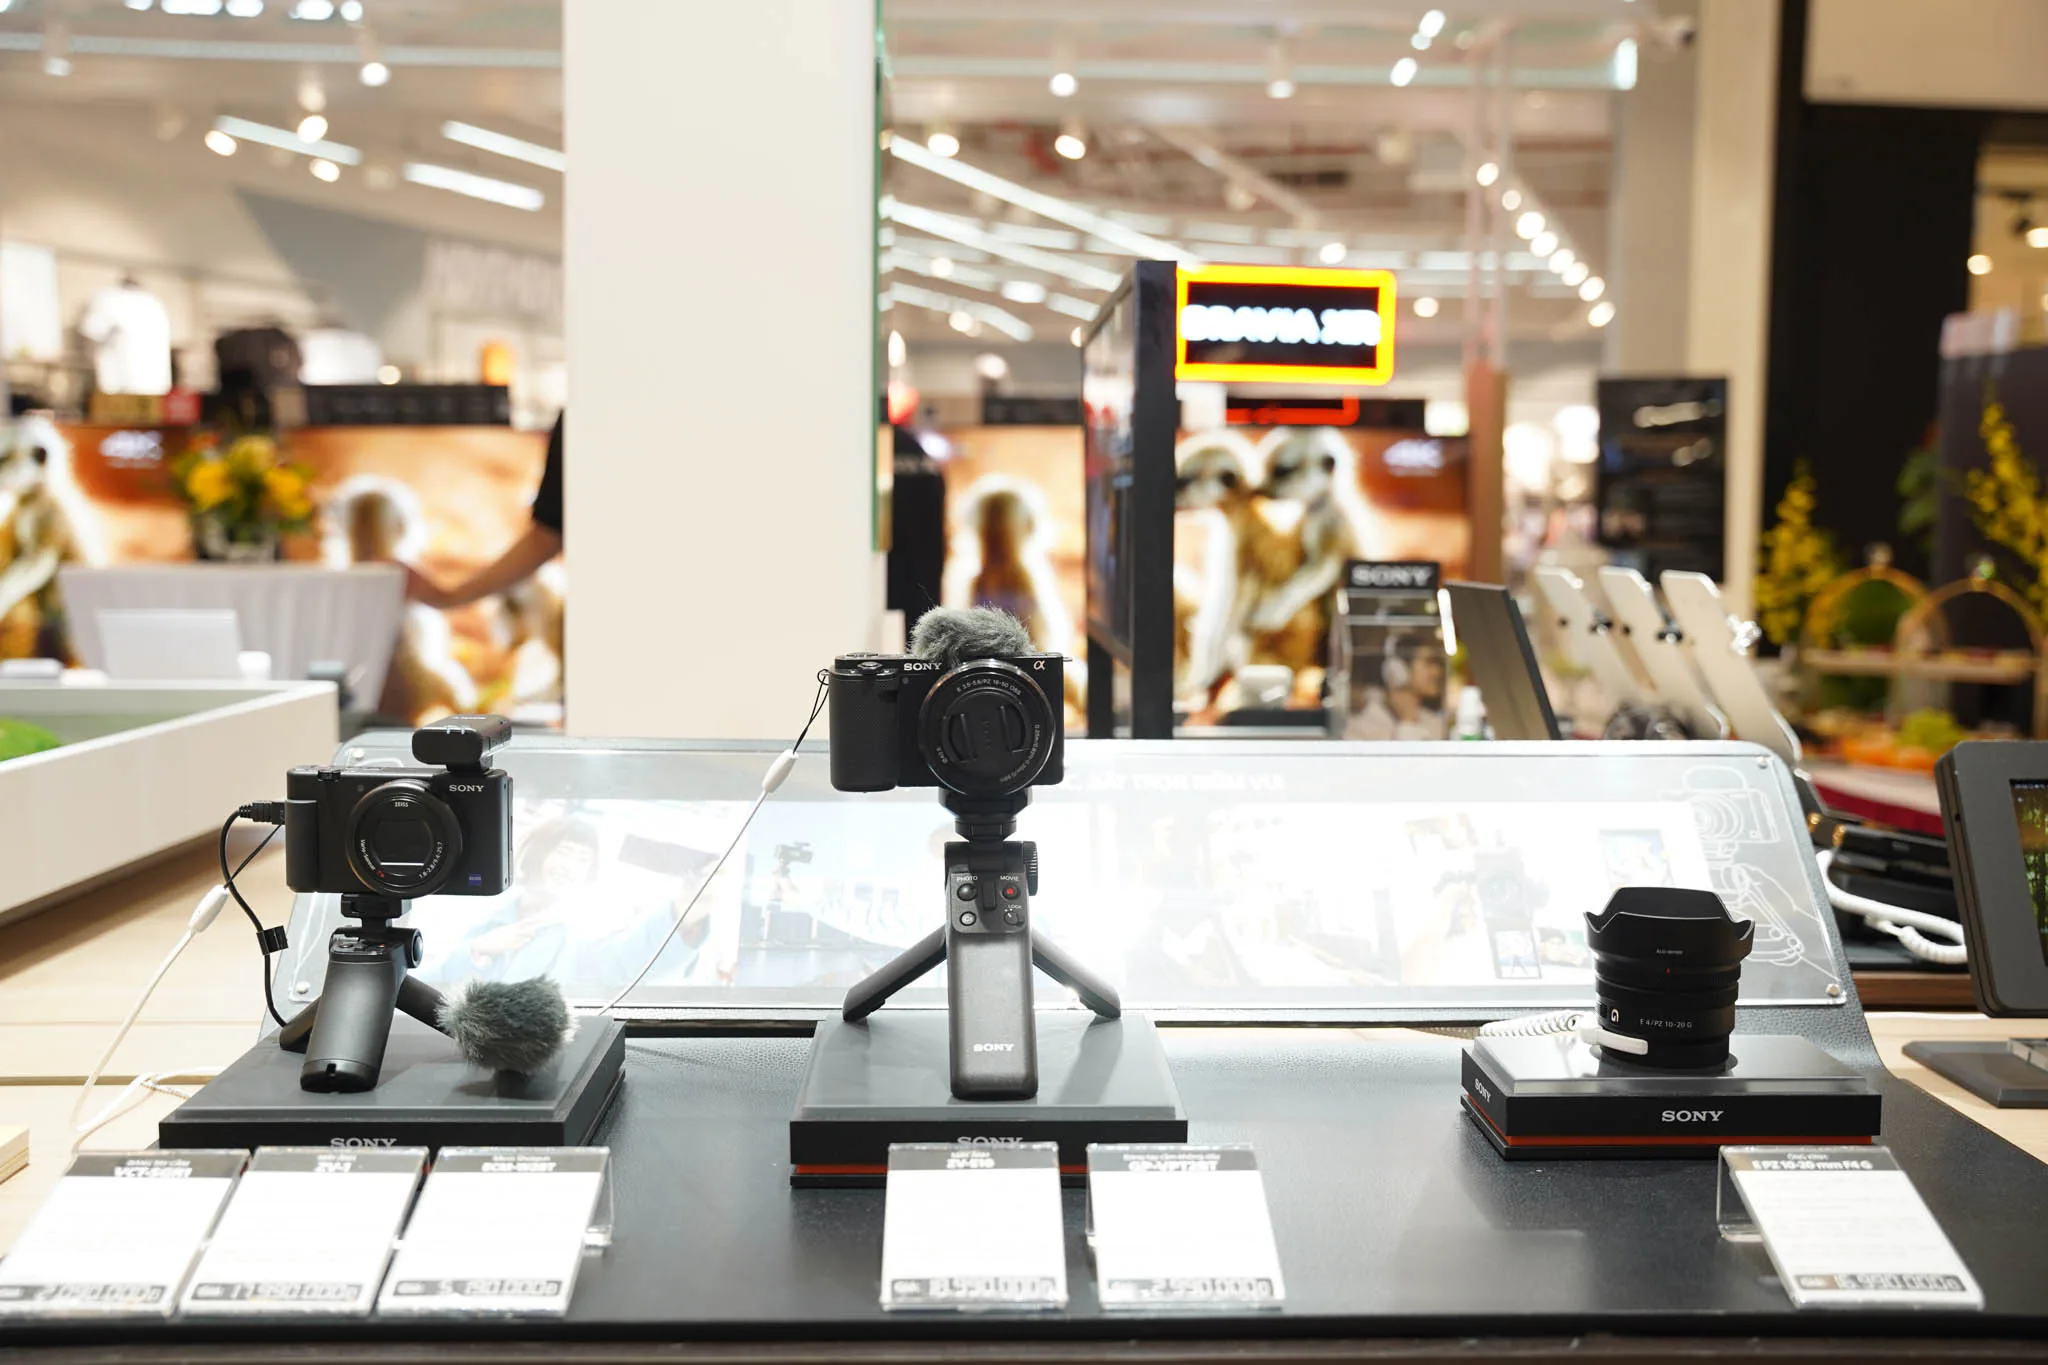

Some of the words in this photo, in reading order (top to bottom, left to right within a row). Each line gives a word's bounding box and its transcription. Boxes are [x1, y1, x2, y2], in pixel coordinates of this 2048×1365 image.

[1352, 565, 1432, 587] SONY
[903, 662, 942, 671] SONY
[449, 784, 485, 792] SONY
[1645, 1019, 1663, 1027] 4/PZ
[973, 1043, 1014, 1052] SONY
[1474, 1078, 1491, 1103] SONY
[1662, 1110, 1724, 1122] SONY
[330, 1137, 397, 1149] SONY
[1762, 1160, 1781, 1170] PZ
[1781, 1160, 1816, 1170] 10-20
[1816, 1161, 1844, 1170] mm
[1844, 1160, 1860, 1170] F4
[1860, 1160, 1873, 1170] G
